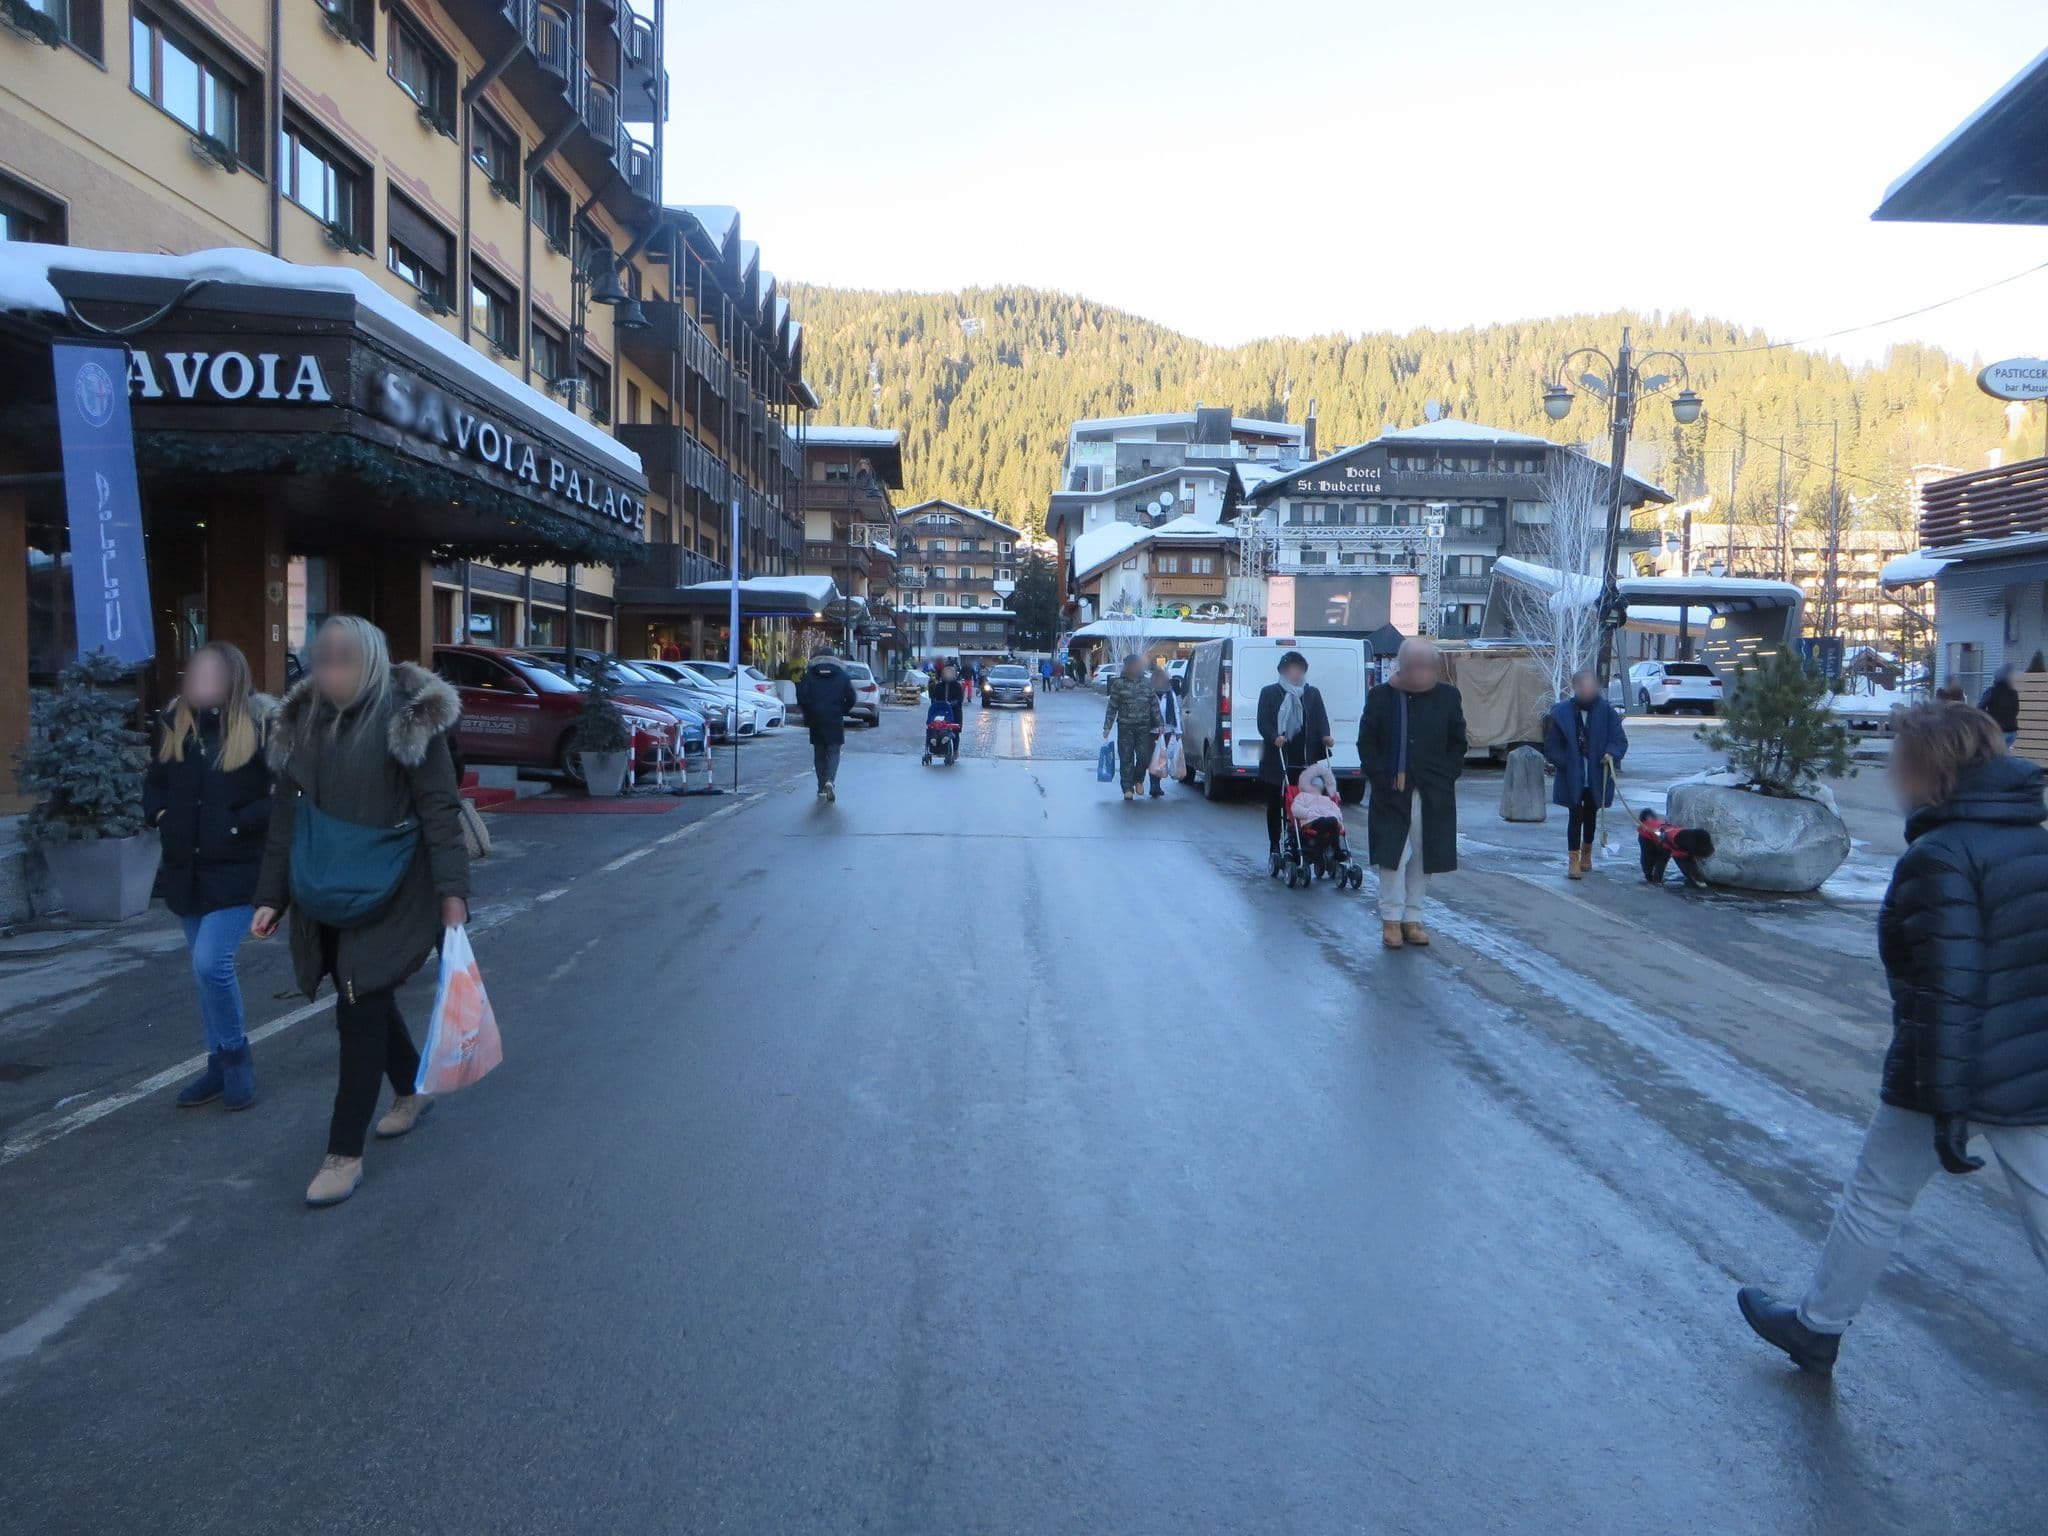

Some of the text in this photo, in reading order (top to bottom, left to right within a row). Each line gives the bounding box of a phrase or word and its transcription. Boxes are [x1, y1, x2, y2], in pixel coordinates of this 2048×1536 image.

[126, 350, 332, 401] AVOIA
[2005, 383, 2019, 392] bar
[1345, 466, 1381, 479] Hotel
[1297, 480, 1381, 493] St. Hubertus
[550, 458, 646, 531] PALACE
